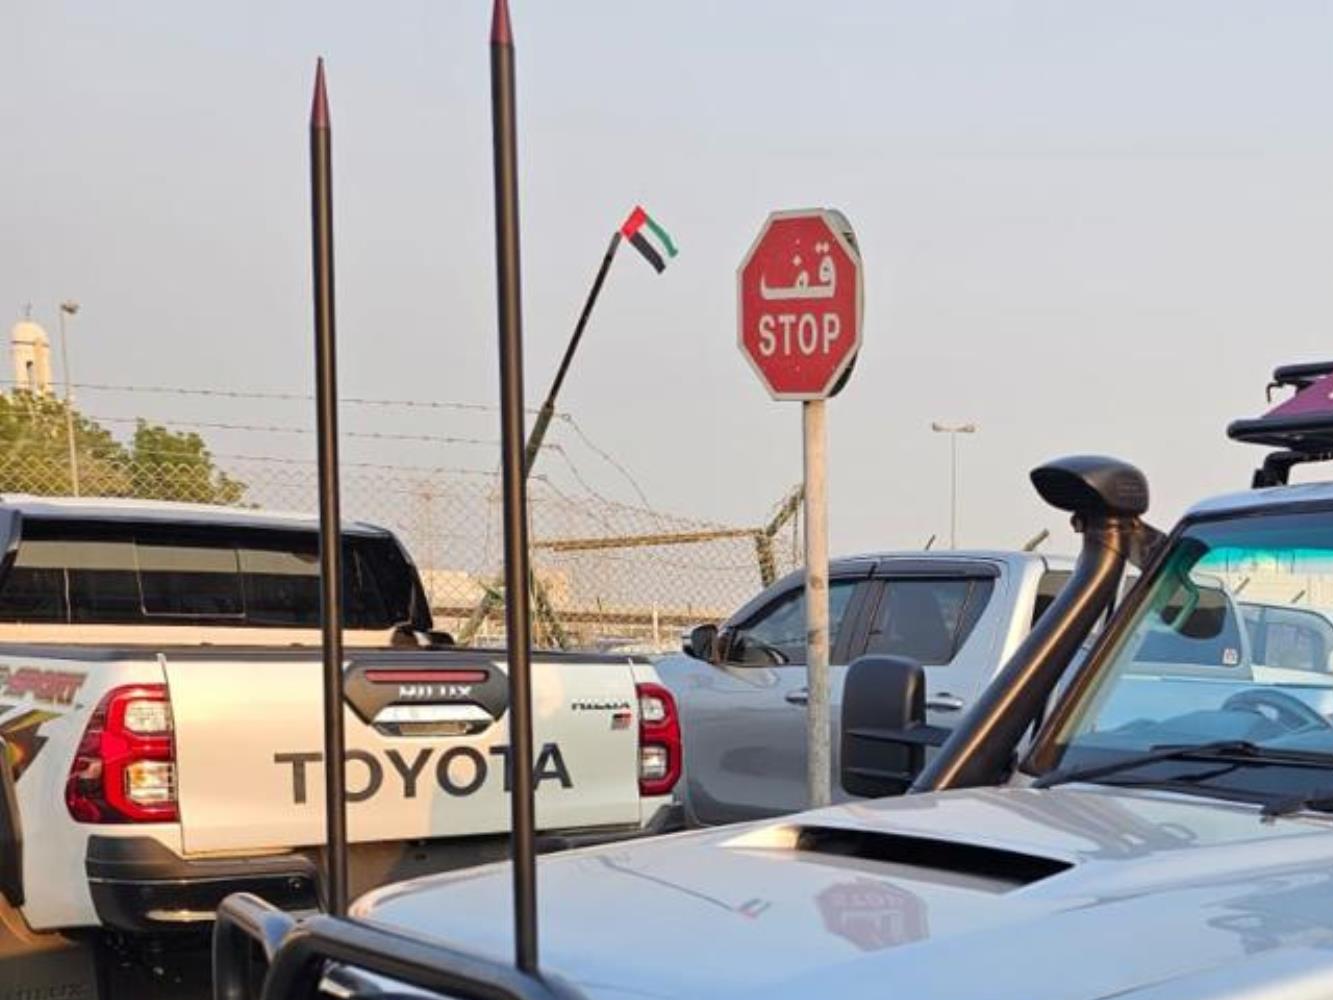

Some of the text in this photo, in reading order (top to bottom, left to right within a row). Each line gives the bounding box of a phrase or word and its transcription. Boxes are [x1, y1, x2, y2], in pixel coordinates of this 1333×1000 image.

[760, 241, 836, 300] قف
[758, 313, 841, 356] STOP
[274, 742, 574, 804] TOYOTA
